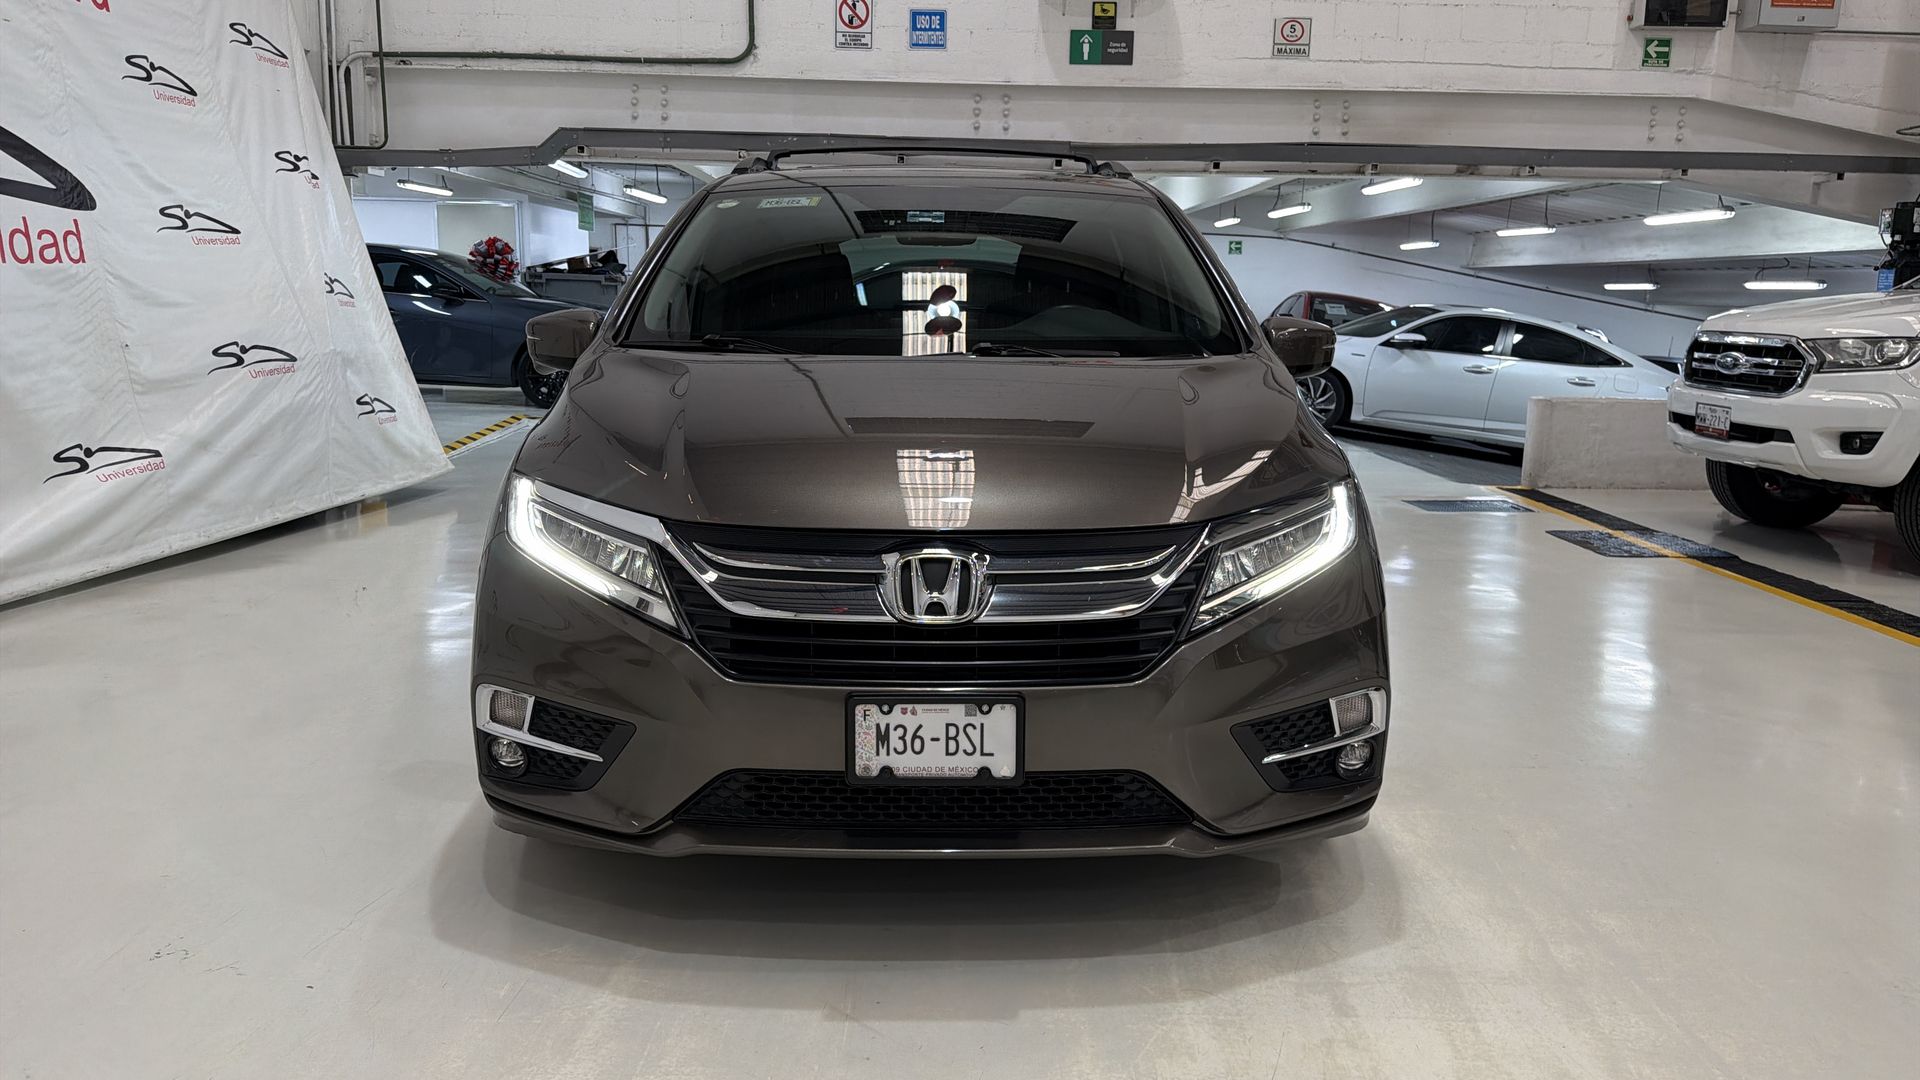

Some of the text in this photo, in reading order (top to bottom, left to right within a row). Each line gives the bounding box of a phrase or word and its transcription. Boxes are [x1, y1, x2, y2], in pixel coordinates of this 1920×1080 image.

[916, 15, 940, 29] USO DE
[1289, 24, 1297, 34] 5
[153, 89, 195, 107] Universidad
[192, 236, 240, 246] Universidad
[249, 364, 296, 379] Universidad
[96, 459, 166, 483] Universidad
[863, 709, 871, 722] F
[875, 723, 995, 757] M36-BSL
[948, 765, 979, 773] MÉXICO
